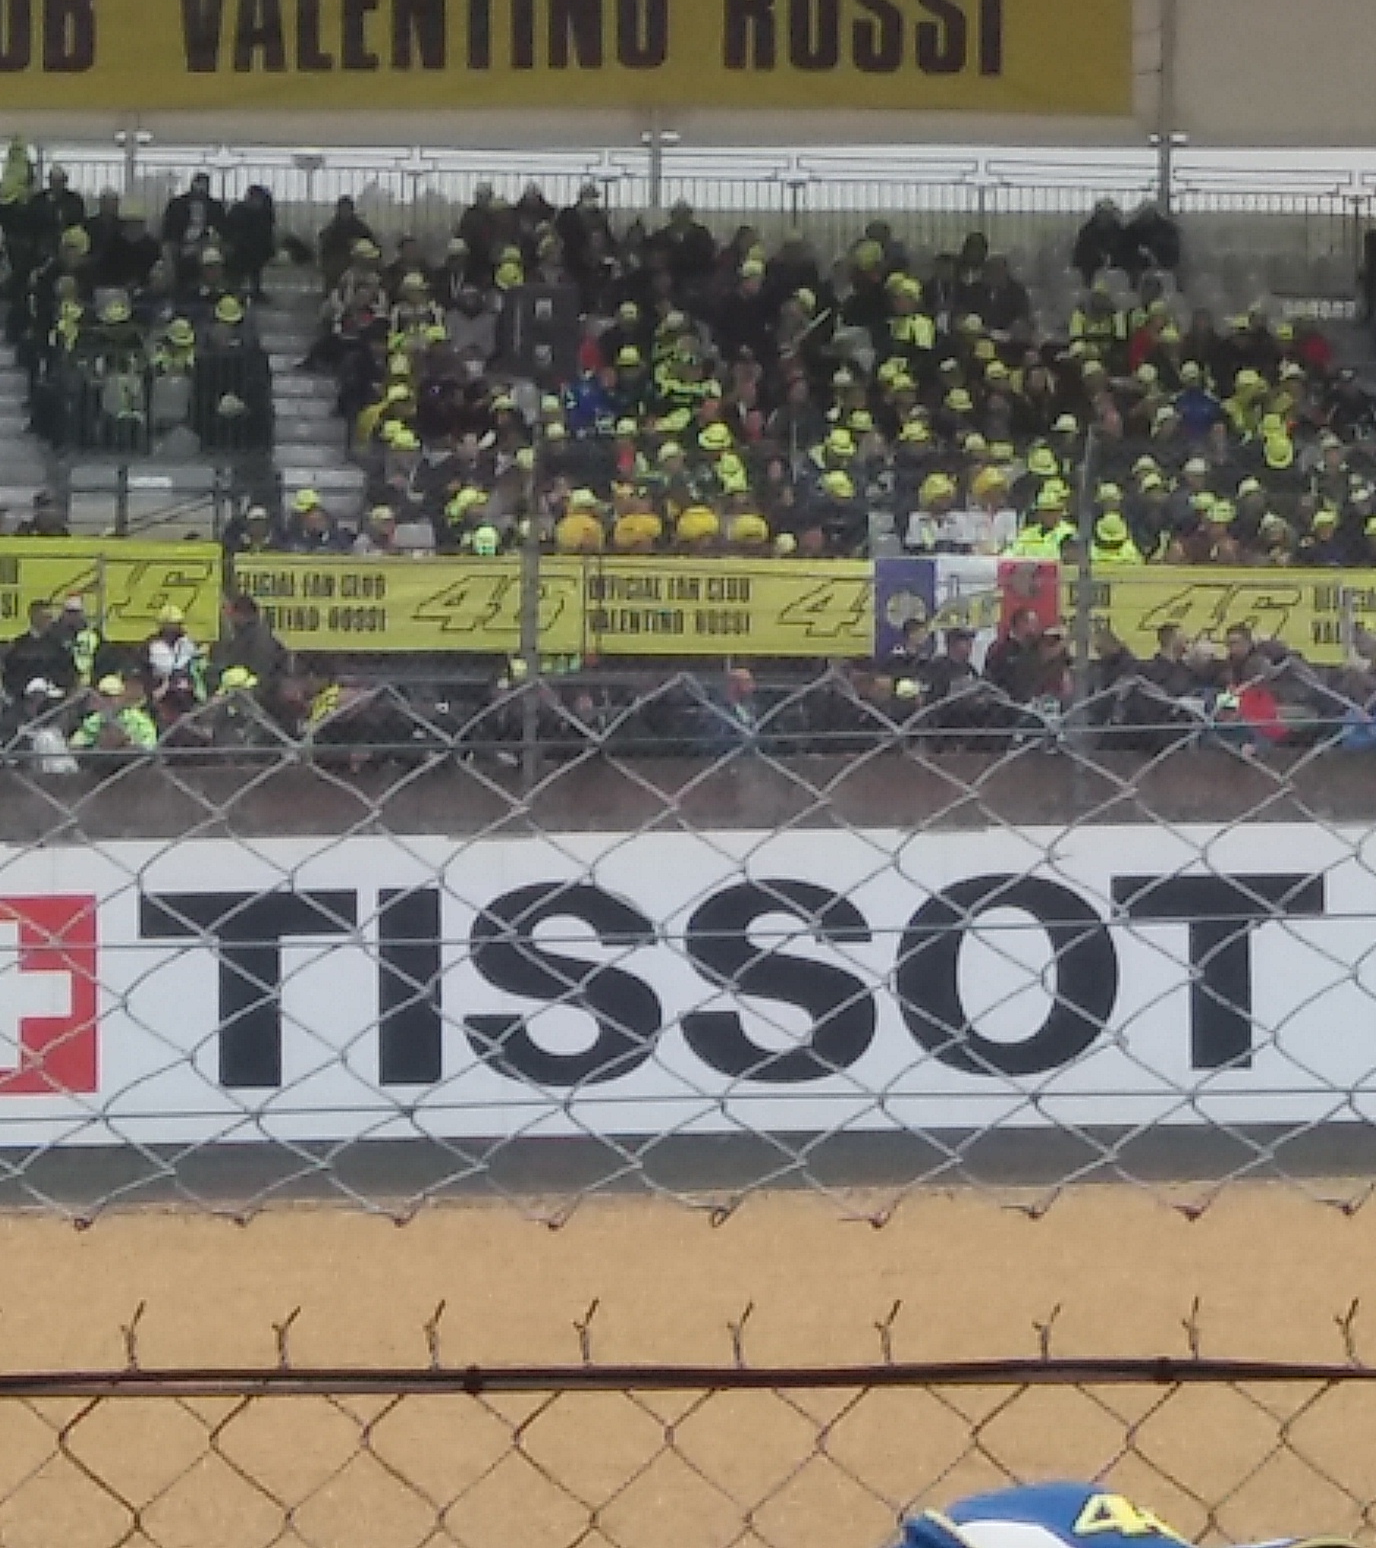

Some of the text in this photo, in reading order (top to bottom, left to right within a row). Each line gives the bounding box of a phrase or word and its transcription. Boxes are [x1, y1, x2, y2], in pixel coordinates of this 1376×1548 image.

[338, 572, 386, 599] CLUB
[668, 575, 701, 602] FAN
[706, 576, 751, 603] CLUB
[327, 605, 386, 632] ROSSI
[694, 609, 751, 635] ROSSI
[776, 578, 870, 639] 4
[140, 871, 1325, 1087] TISSOT
